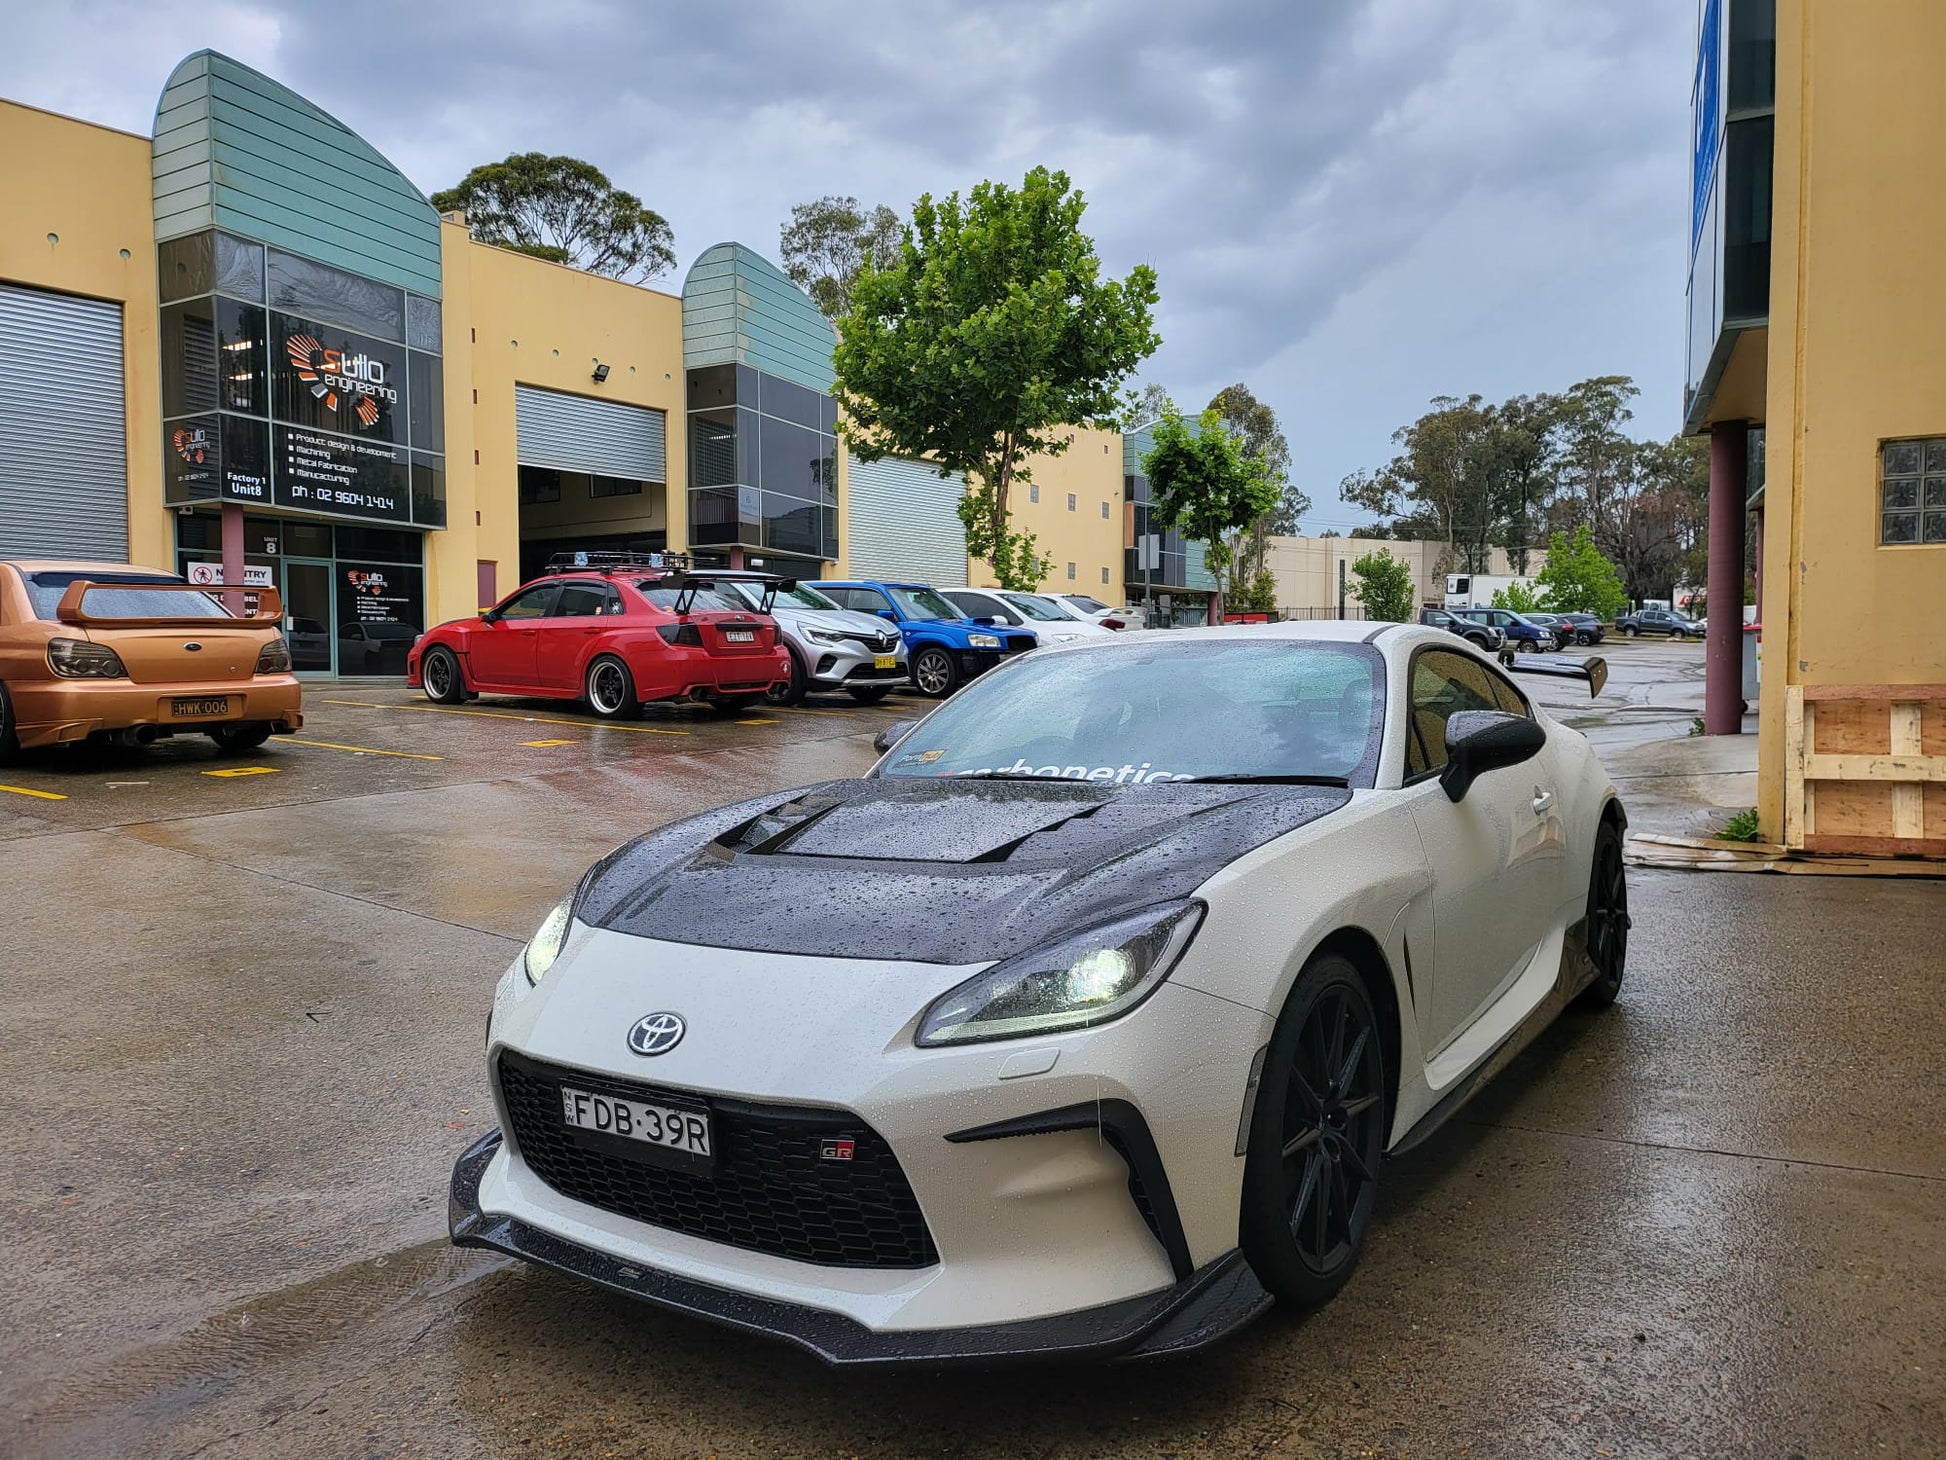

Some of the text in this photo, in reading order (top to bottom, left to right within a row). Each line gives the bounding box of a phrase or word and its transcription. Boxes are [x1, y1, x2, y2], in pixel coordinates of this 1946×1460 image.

[324, 373, 397, 404] engineering
[295, 433, 398, 460] Product design & development
[296, 457, 358, 474] Metal Fabrication
[227, 472, 266, 485] Factory 1
[231, 482, 262, 496] Unit8
[292, 485, 308, 498] ph
[317, 488, 332, 502] 02
[335, 491, 364, 506] 9604
[366, 495, 394, 510] 1414
[266, 542, 276, 554] 8
[822, 1147, 852, 1158] GR
